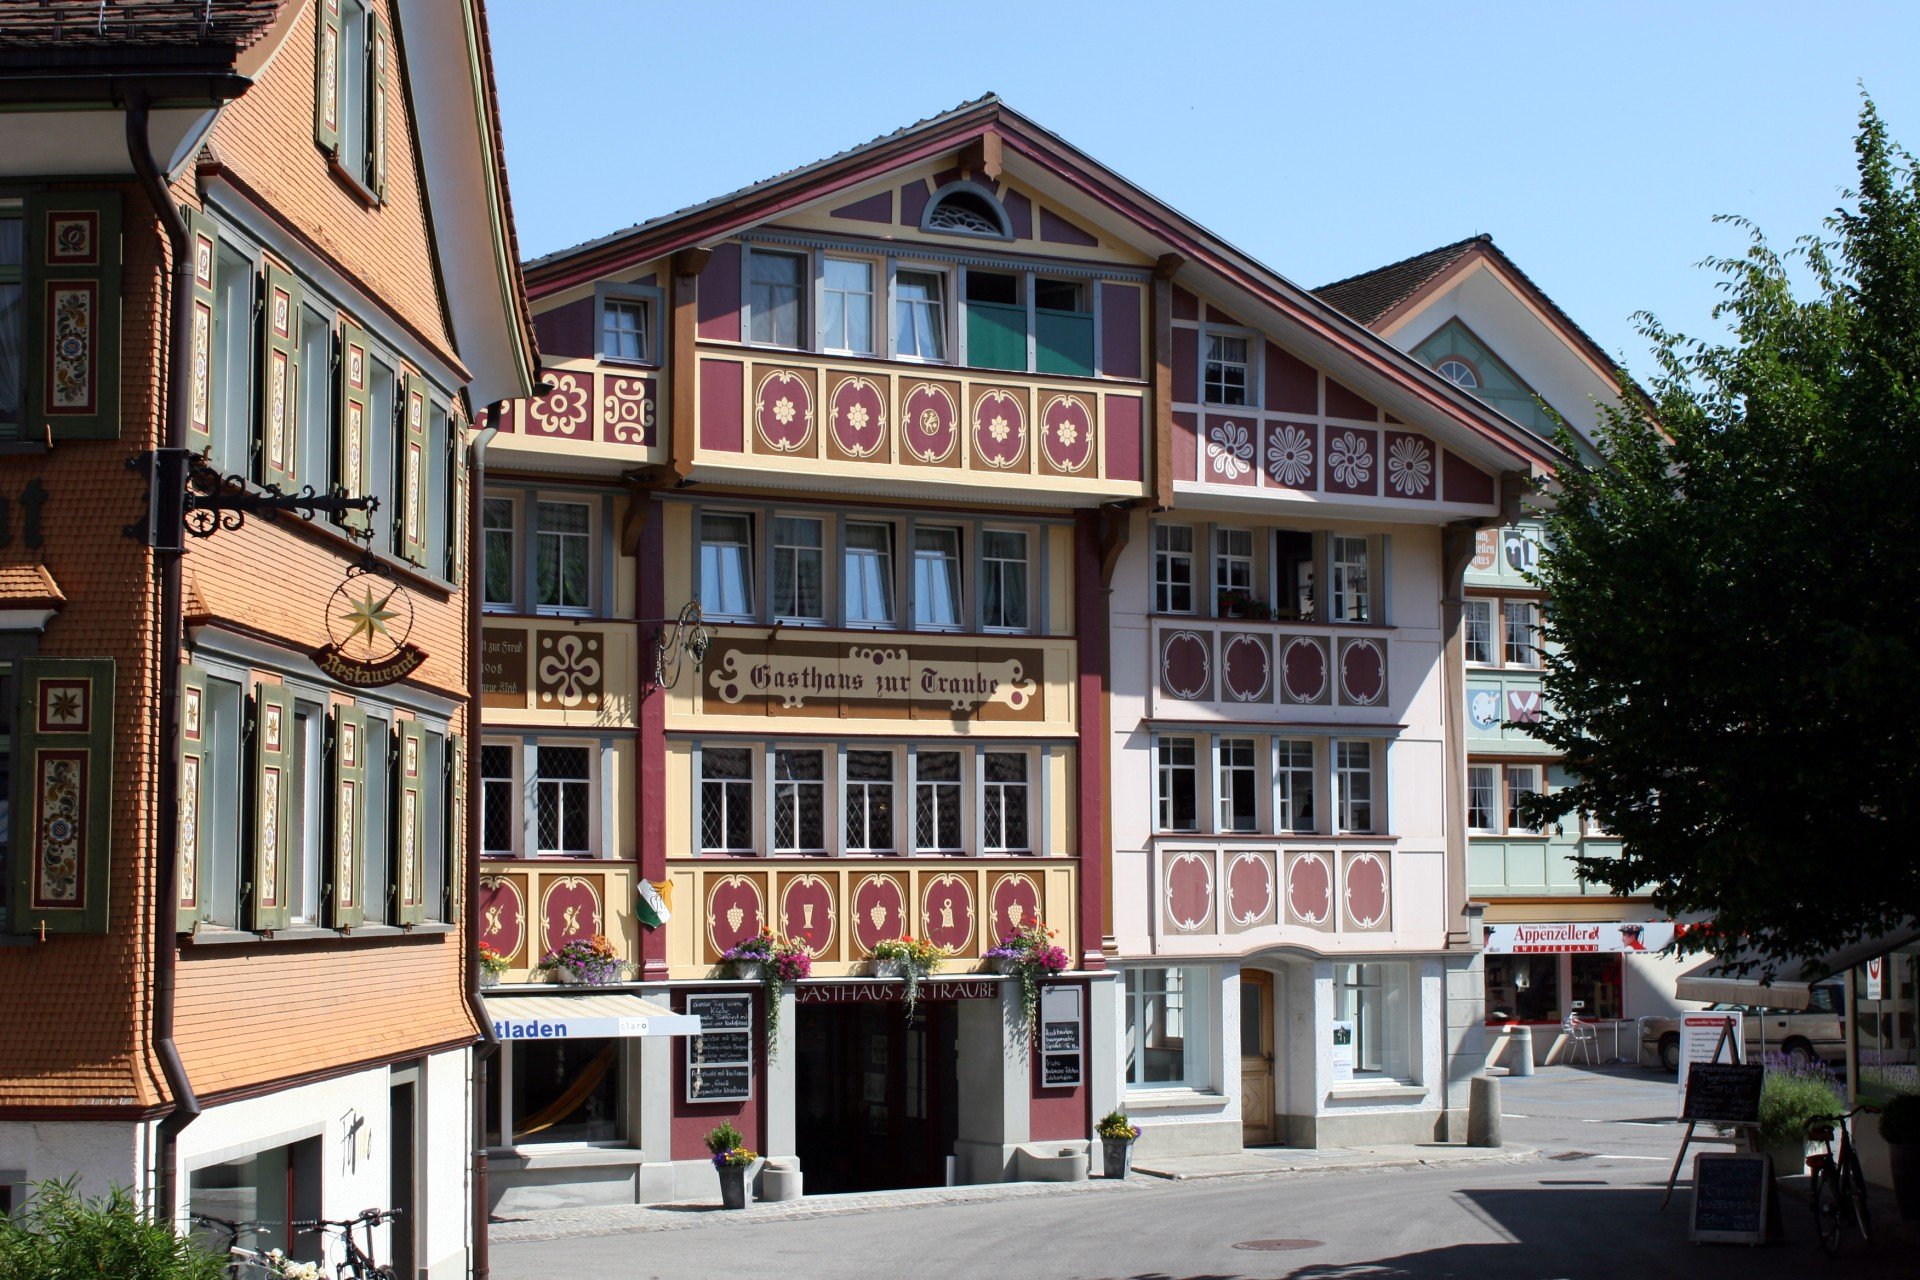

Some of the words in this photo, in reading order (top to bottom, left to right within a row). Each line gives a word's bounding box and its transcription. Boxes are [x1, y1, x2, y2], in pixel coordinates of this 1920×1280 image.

[320, 652, 418, 683] Restaurant
[750, 664, 863, 695] Gasthaus
[875, 675, 911, 697] zur
[921, 667, 999, 695] Traube
[1514, 925, 1588, 944] Appenzeller
[794, 984, 893, 1002] GASTHAUS
[927, 982, 995, 999] TRAUBE
[492, 1020, 567, 1038] tladen
[621, 1021, 647, 1030] claro
